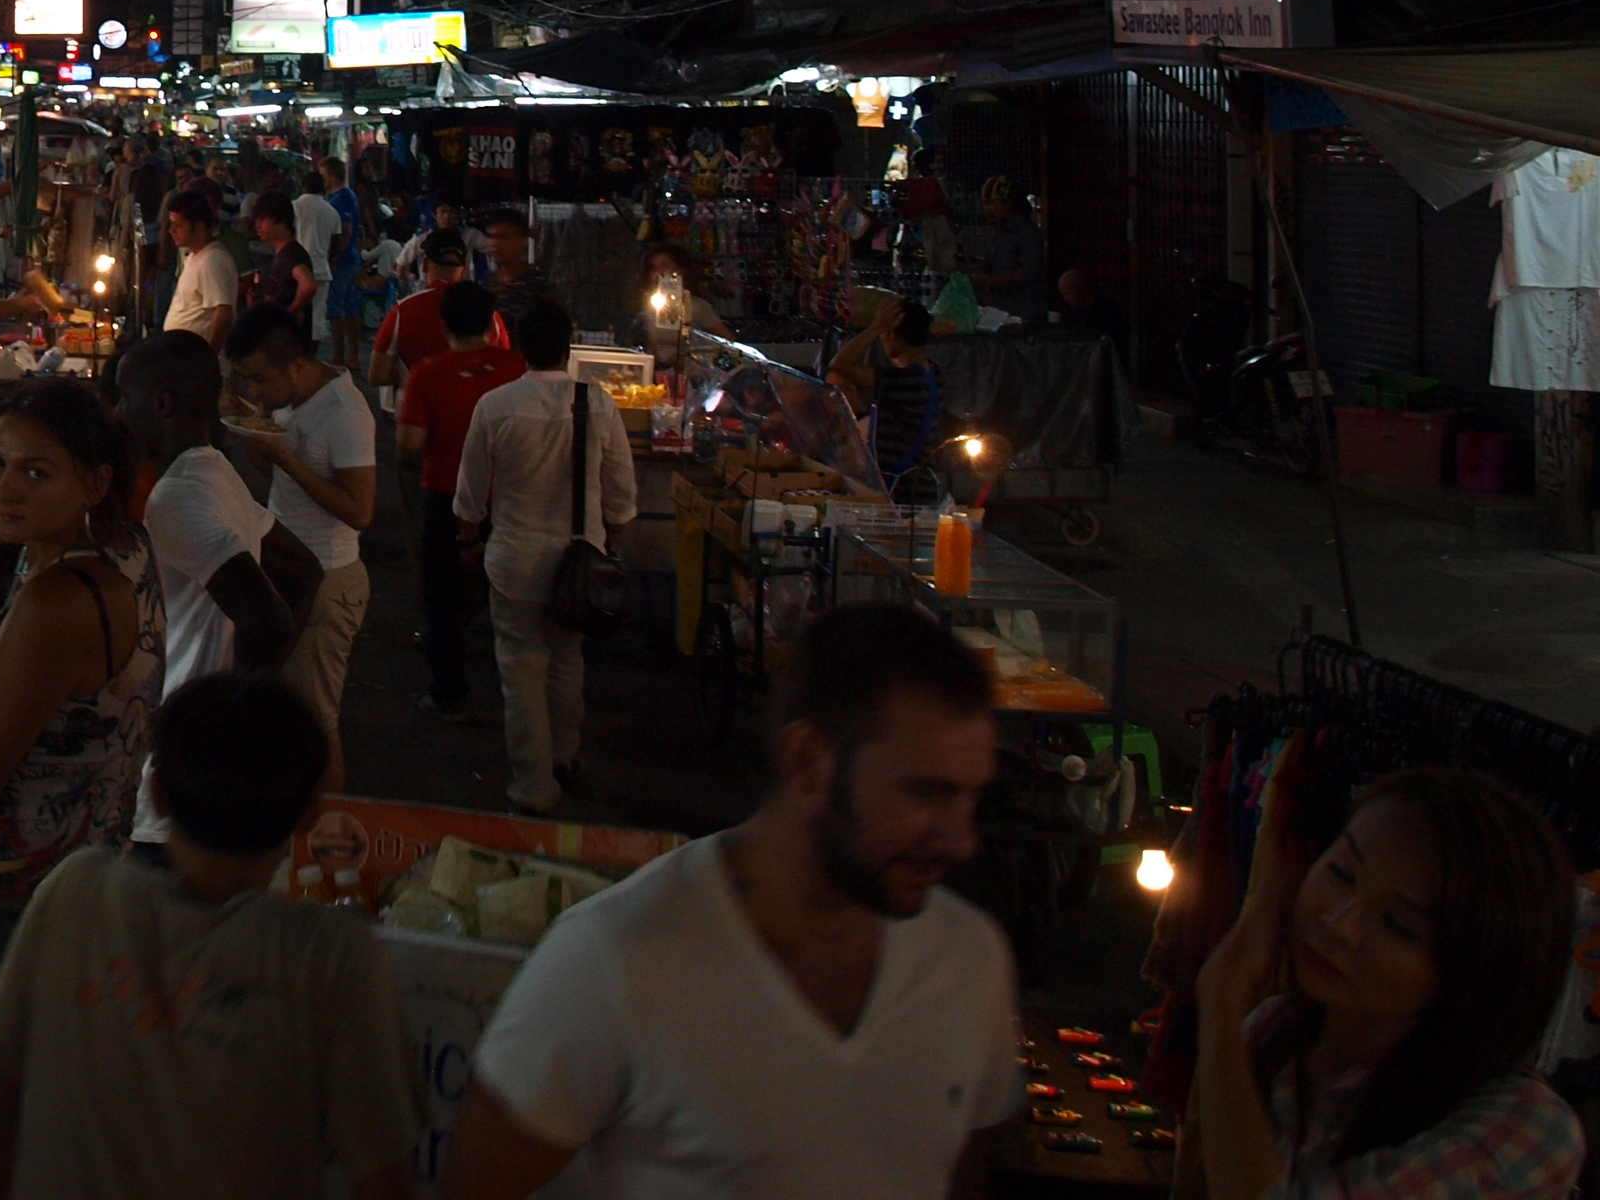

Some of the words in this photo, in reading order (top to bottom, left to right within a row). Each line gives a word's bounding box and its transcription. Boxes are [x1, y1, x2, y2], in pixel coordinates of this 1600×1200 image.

[1120, 6, 1180, 36] Sawasdee
[1185, 7, 1244, 39] Bangkok
[1248, 9, 1272, 37] Inn
[469, 134, 516, 152] KHAO
